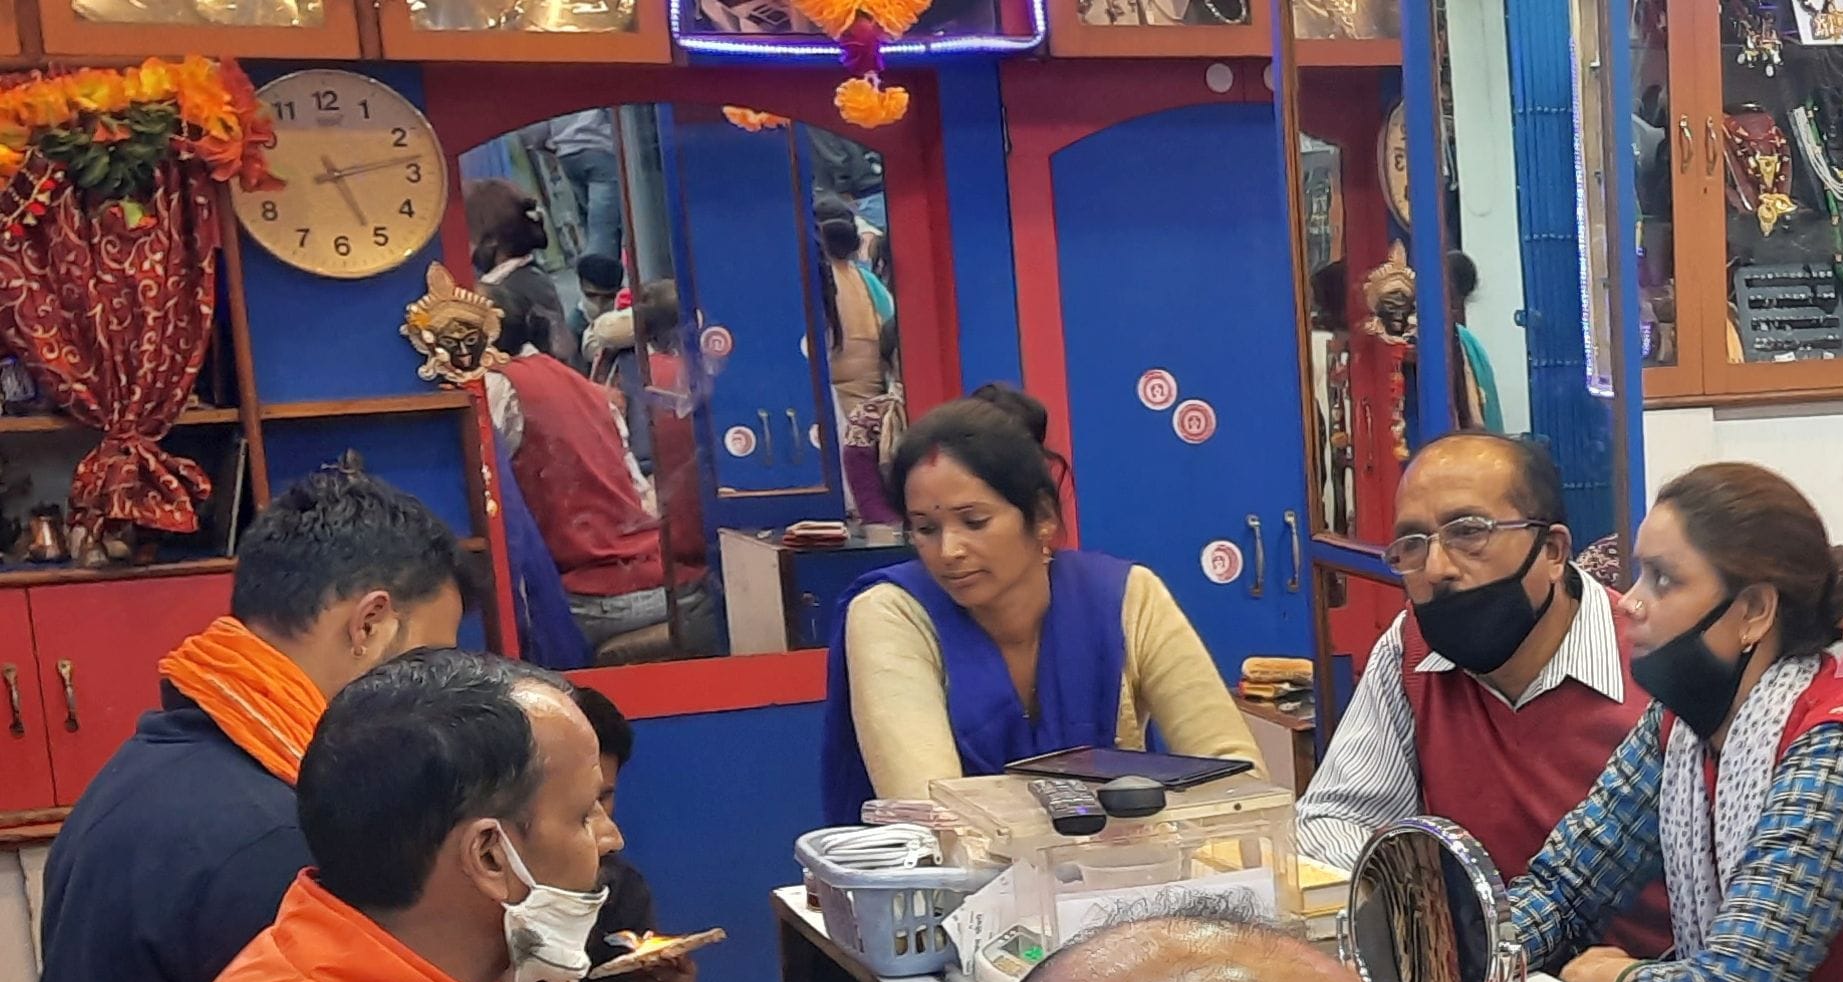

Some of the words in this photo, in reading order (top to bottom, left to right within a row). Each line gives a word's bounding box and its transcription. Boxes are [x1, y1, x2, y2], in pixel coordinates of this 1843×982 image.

[272, 101, 295, 120] 11
[312, 91, 339, 111] 12
[359, 99, 370, 119] 1
[391, 128, 407, 147] 2
[406, 163, 421, 183] 3
[262, 201, 278, 221] 8
[400, 199, 414, 218] 4
[296, 228, 310, 247] 7
[334, 236, 350, 256] 6
[373, 226, 389, 246] 5
